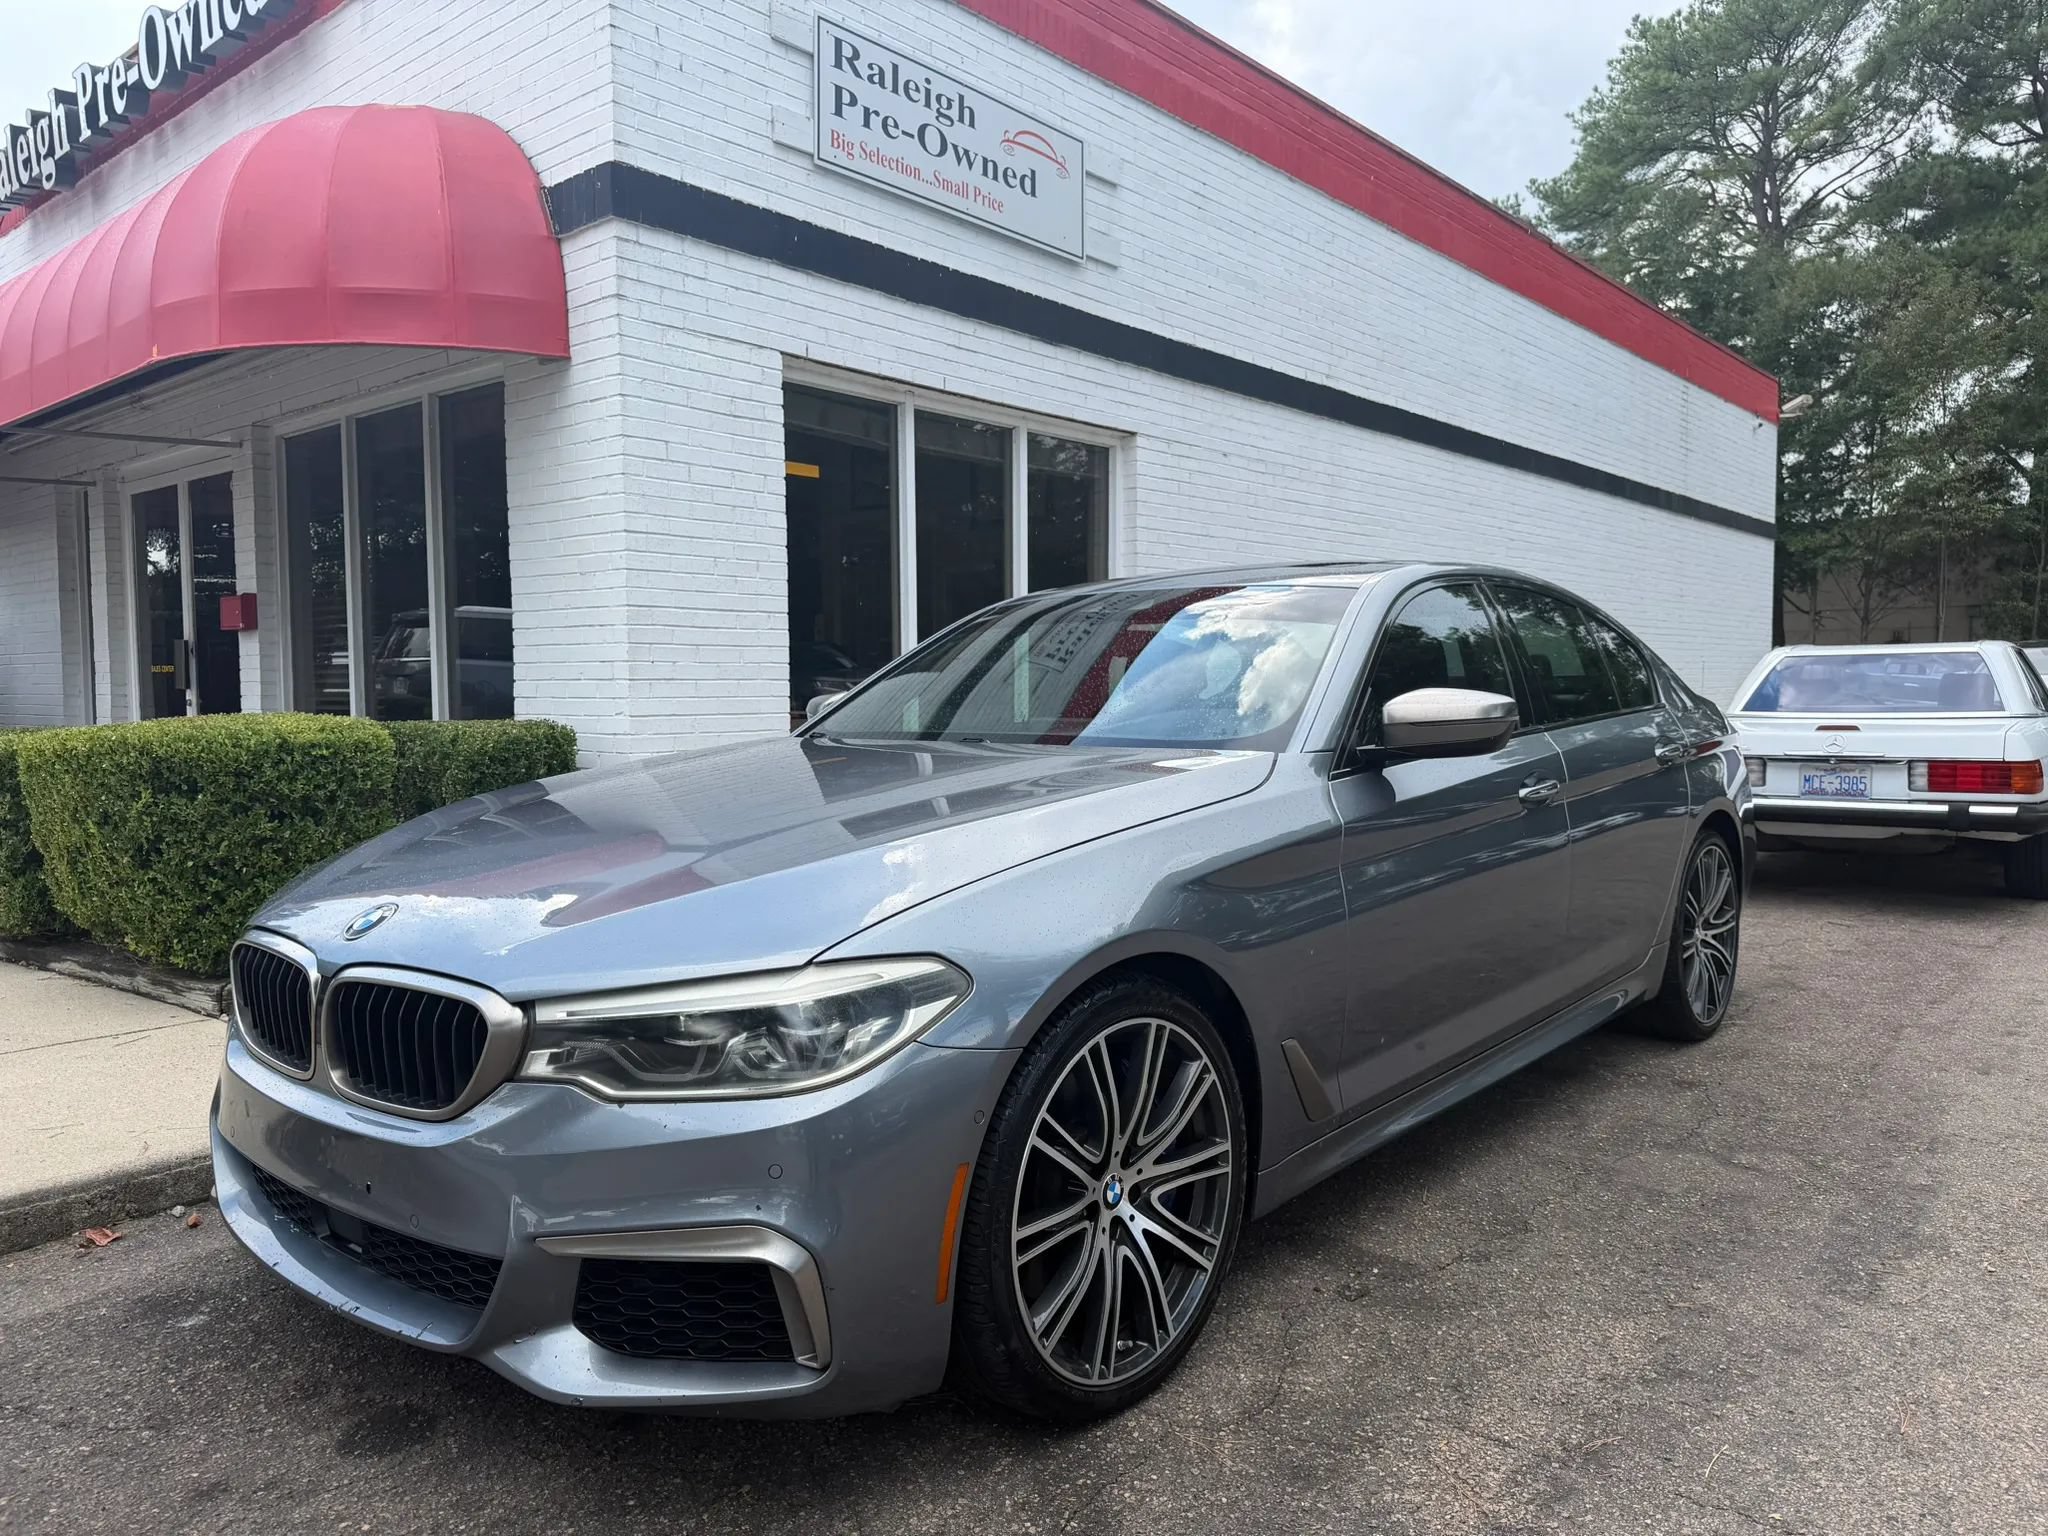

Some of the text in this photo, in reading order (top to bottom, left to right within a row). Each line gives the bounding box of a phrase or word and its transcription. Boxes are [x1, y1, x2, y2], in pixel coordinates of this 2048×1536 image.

[73, 0, 268, 143] Pre-Owne
[830, 34, 976, 129] Raleigh
[830, 82, 1038, 198] Pre-Owned
[830, 129, 855, 161] Big
[974, 186, 1005, 213] Price
